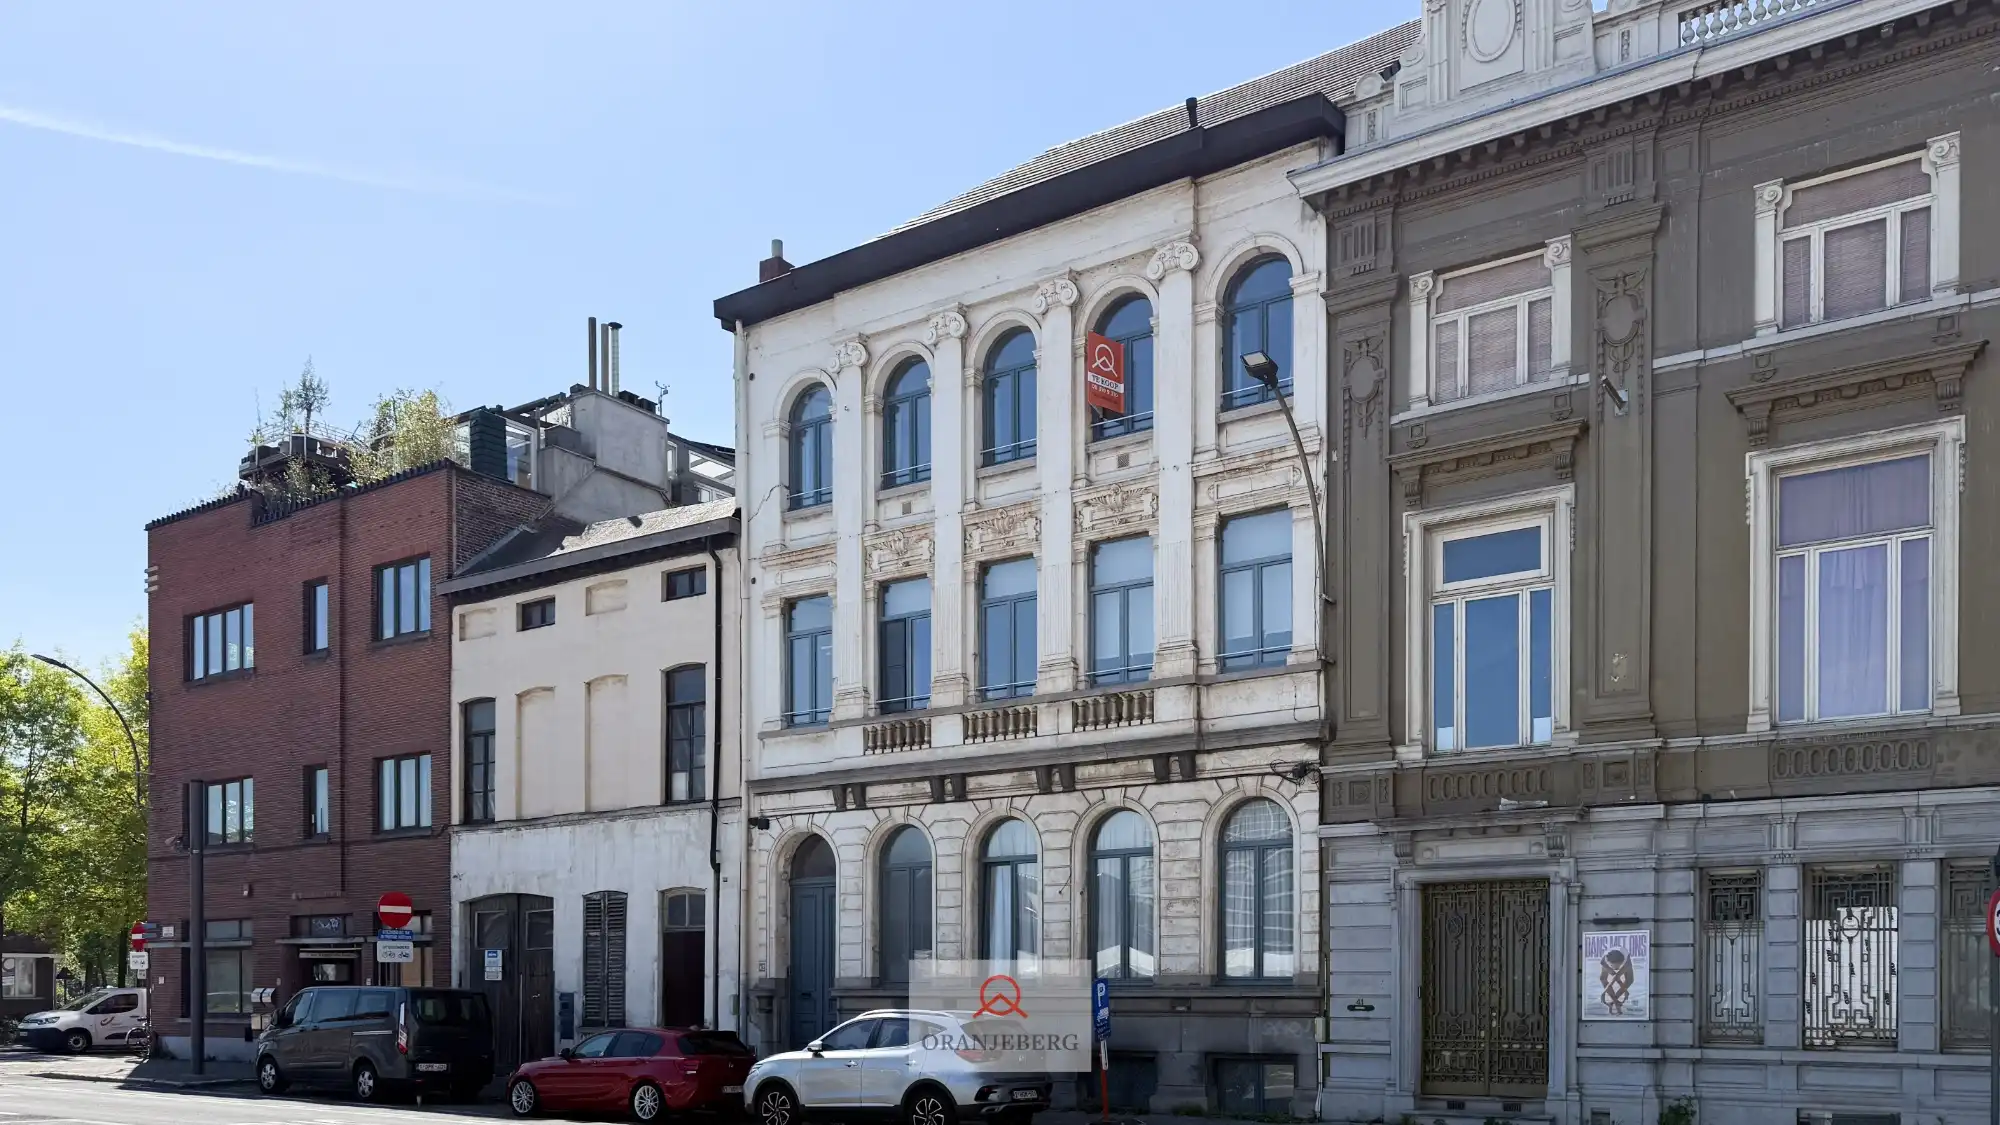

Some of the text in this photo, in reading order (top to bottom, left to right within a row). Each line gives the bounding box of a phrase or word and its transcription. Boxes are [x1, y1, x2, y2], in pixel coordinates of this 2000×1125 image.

[1092, 375, 1101, 384] TE
[1585, 936, 1608, 958] DANS
[1629, 935, 1647, 957] ONS
[1097, 982, 1106, 1007] P
